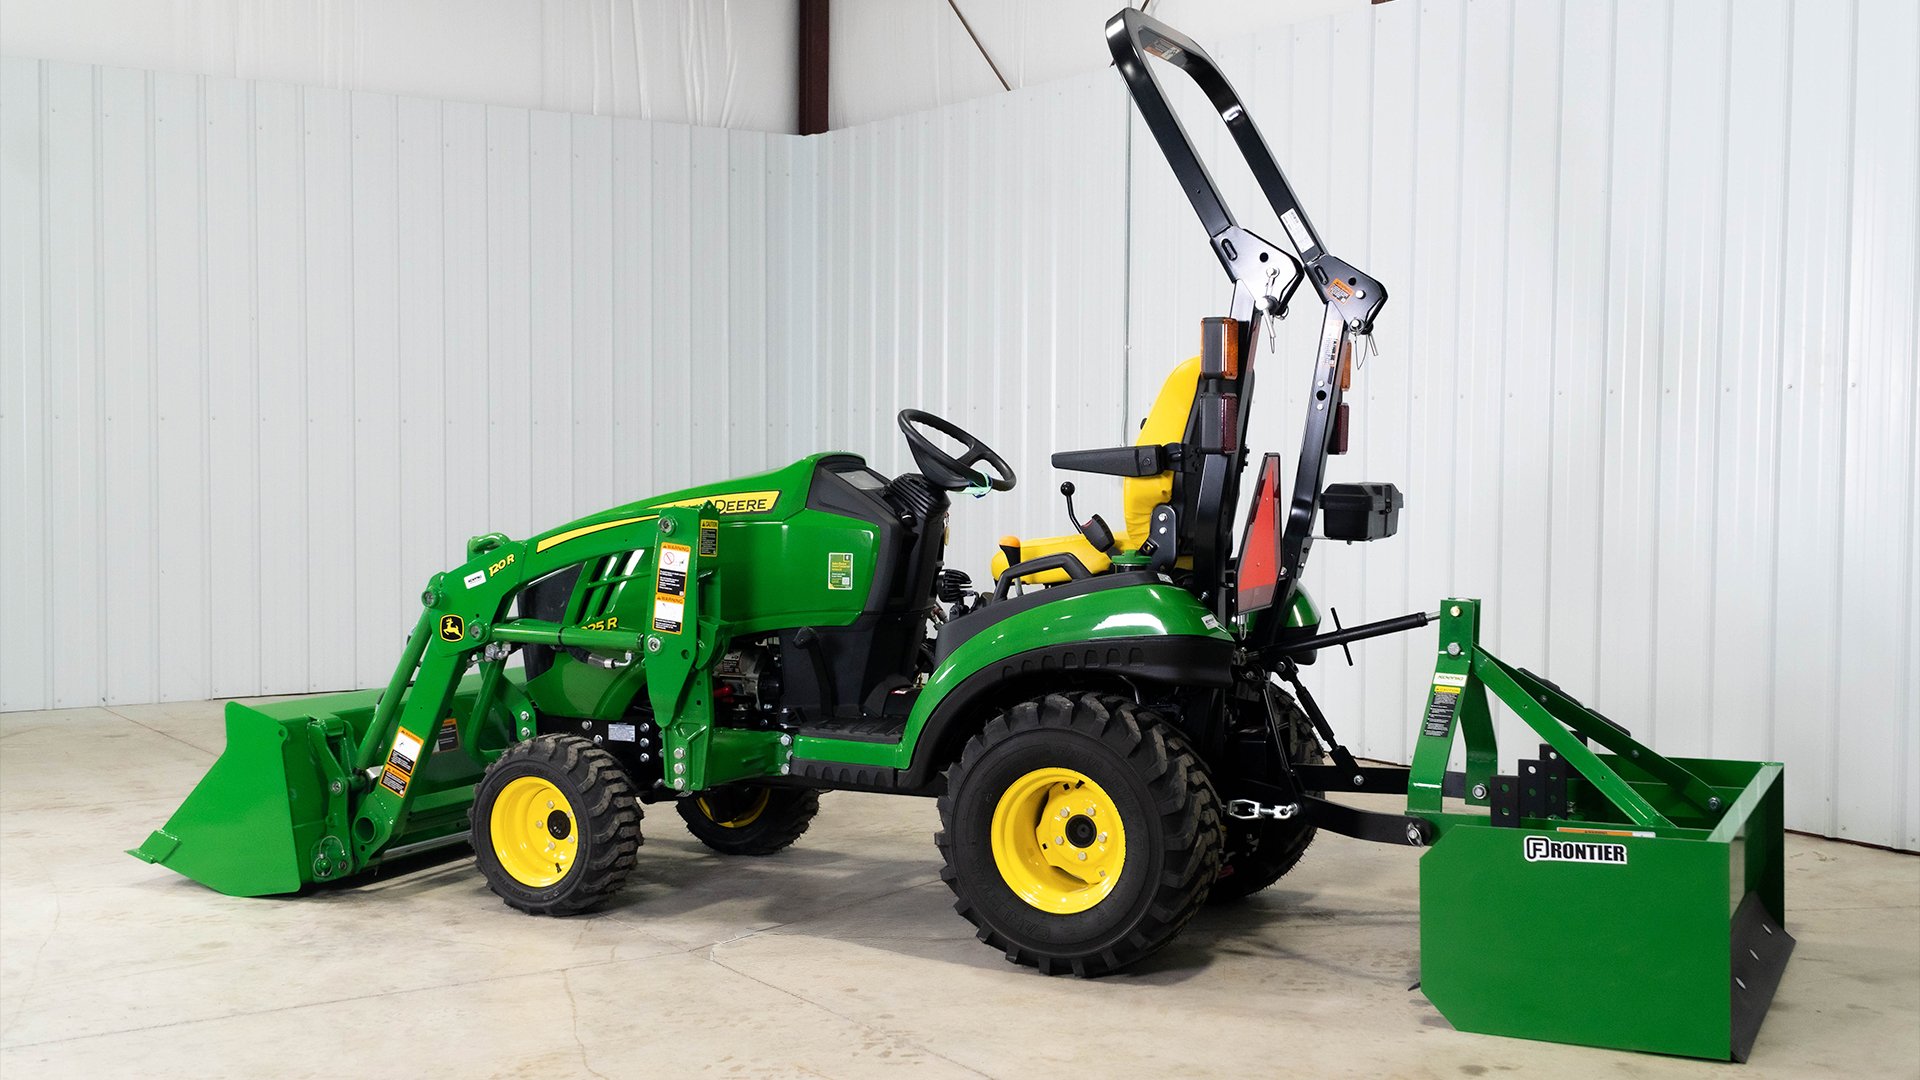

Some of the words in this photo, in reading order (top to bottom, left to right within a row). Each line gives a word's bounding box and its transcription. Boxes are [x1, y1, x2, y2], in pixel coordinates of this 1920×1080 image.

[714, 499, 768, 512] DEERE
[667, 544, 690, 552] WARNING
[488, 559, 506, 577] 120
[507, 553, 515, 565] R
[661, 596, 684, 604] WARNING
[607, 616, 618, 630] R
[1526, 837, 1625, 862] FRONTIER
